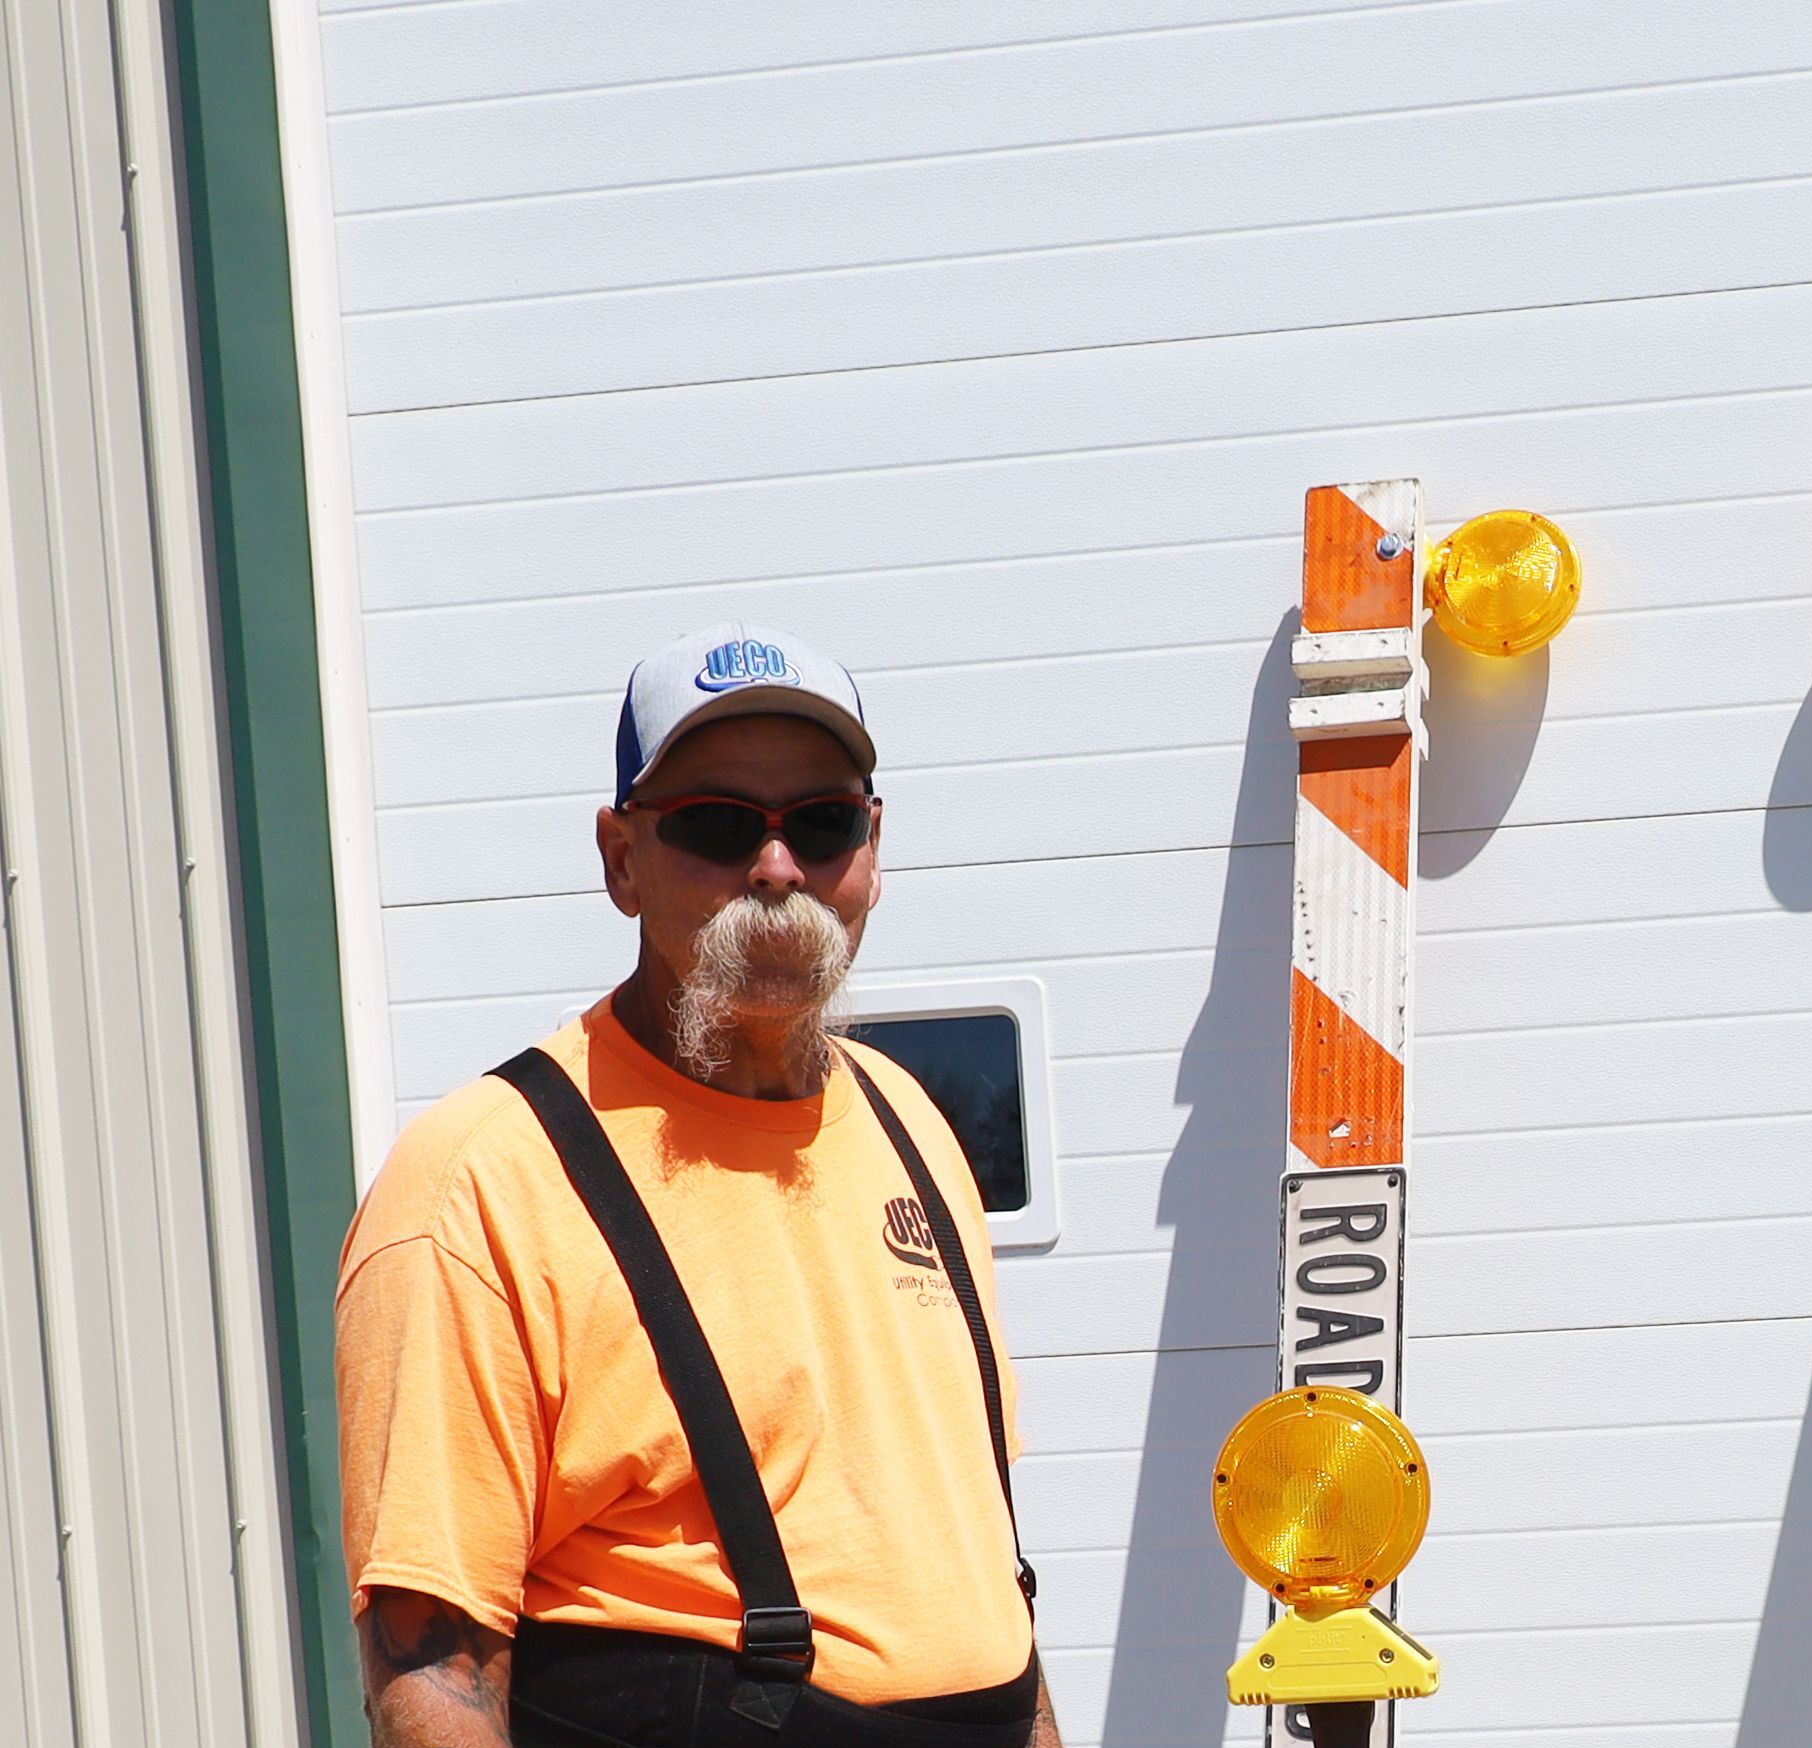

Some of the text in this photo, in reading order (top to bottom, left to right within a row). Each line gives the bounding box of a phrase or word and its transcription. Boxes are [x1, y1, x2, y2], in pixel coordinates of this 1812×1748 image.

[706, 639, 787, 680] UECO
[884, 1197, 933, 1251] UEC
[892, 1275, 924, 1290] Utility
[1295, 1204, 1388, 1395] ROAD
